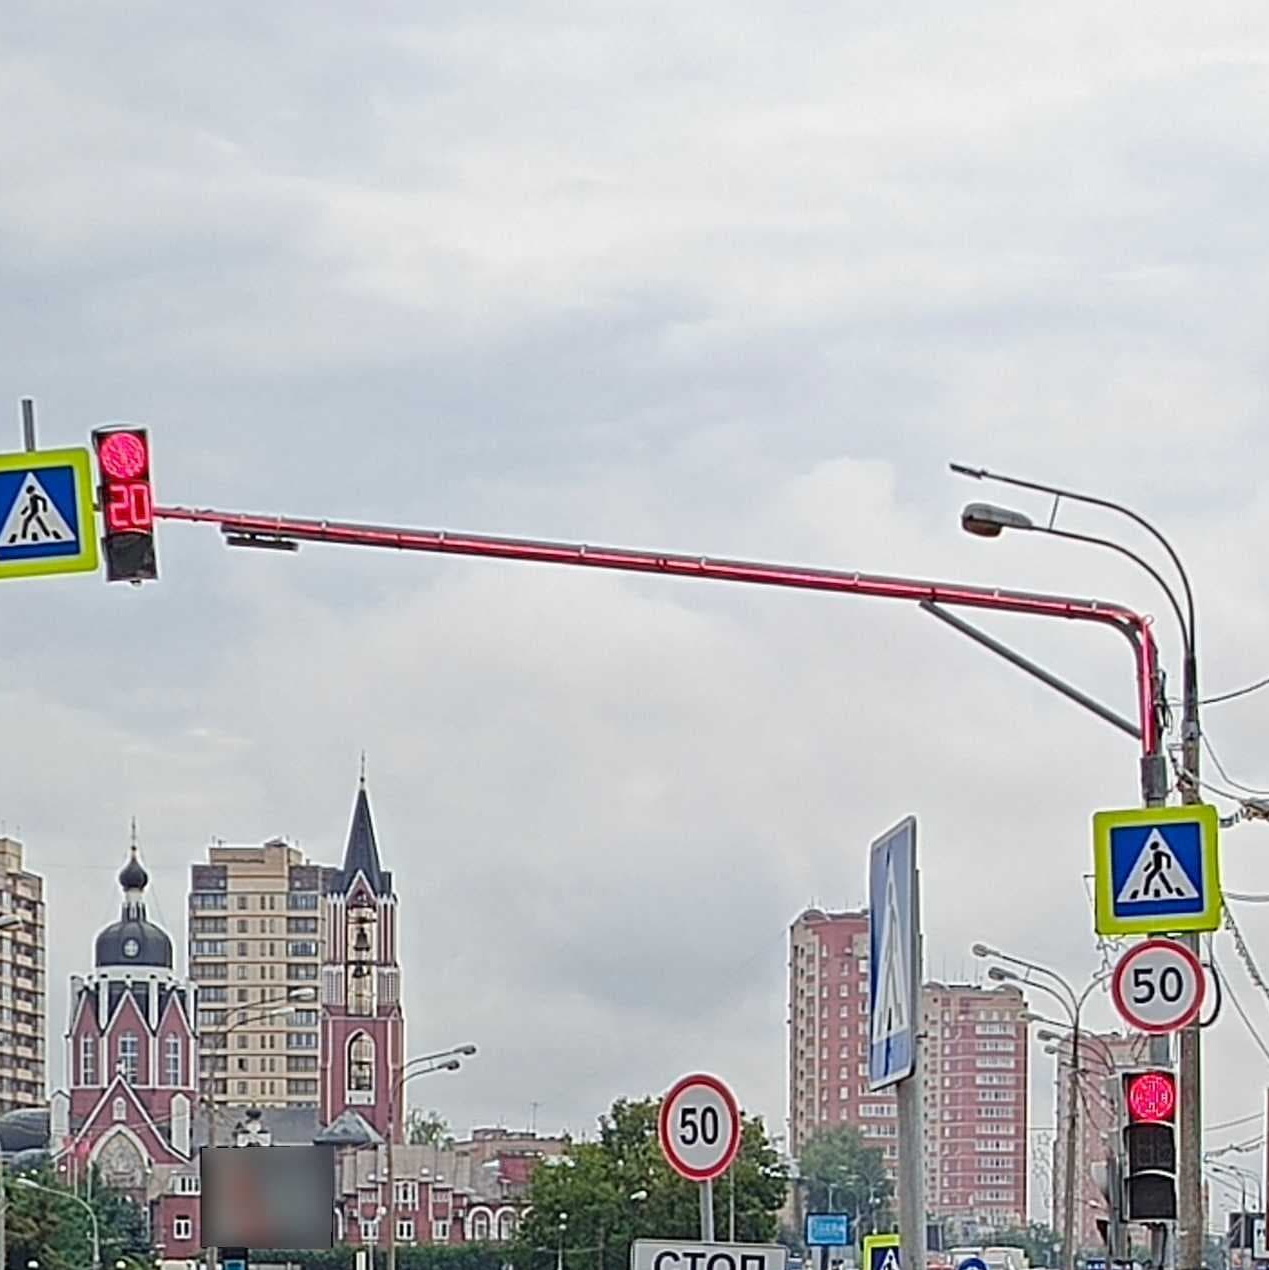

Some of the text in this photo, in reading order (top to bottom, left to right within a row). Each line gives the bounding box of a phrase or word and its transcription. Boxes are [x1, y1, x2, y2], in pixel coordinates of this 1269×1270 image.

[109, 484, 150, 527] 20
[1133, 966, 1184, 1004] 50
[680, 1106, 719, 1145] 50
